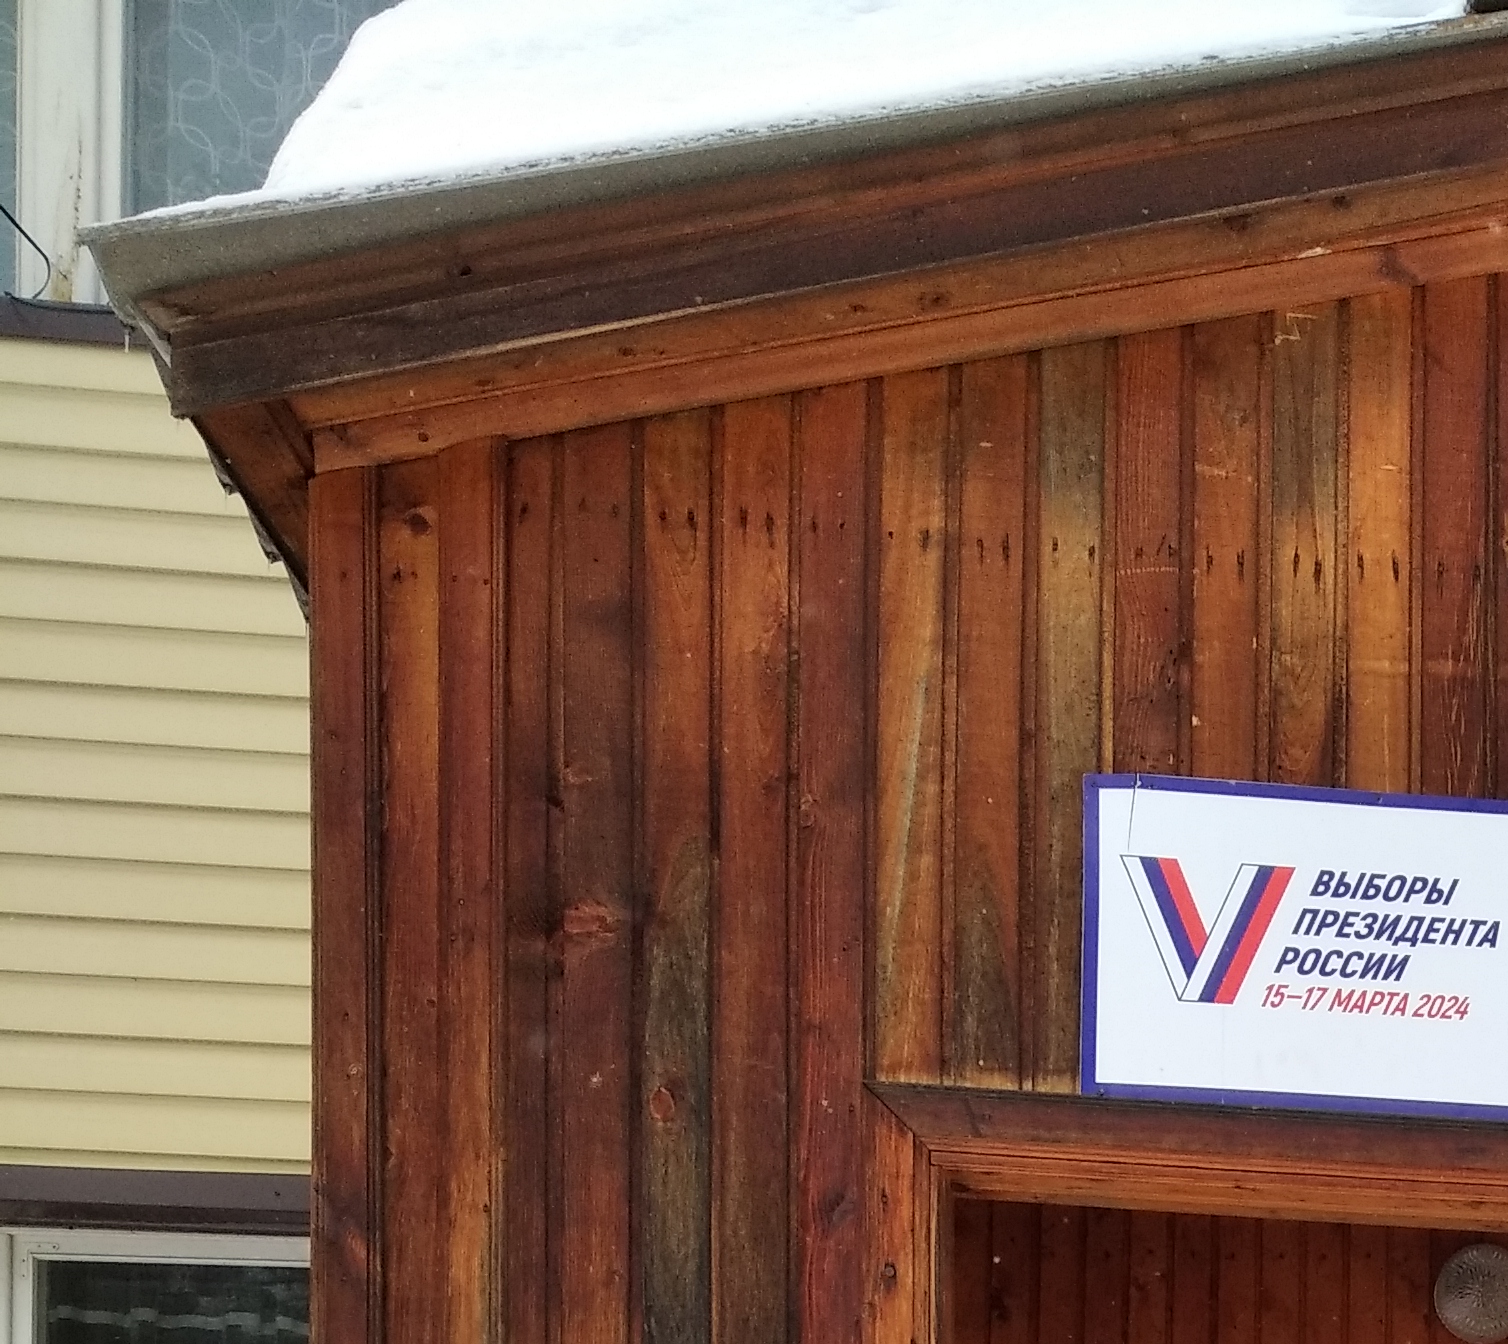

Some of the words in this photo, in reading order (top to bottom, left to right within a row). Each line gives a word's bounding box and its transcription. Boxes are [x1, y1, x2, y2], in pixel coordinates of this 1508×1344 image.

[1309, 869, 1460, 906] ВЫБОРЫ
[1290, 907, 1501, 951] ПРЕЗИДЕНТА
[1273, 946, 1412, 982] РОССИИ
[1328, 987, 1409, 1017] МАРТА
[1411, 993, 1470, 1021] 2024
